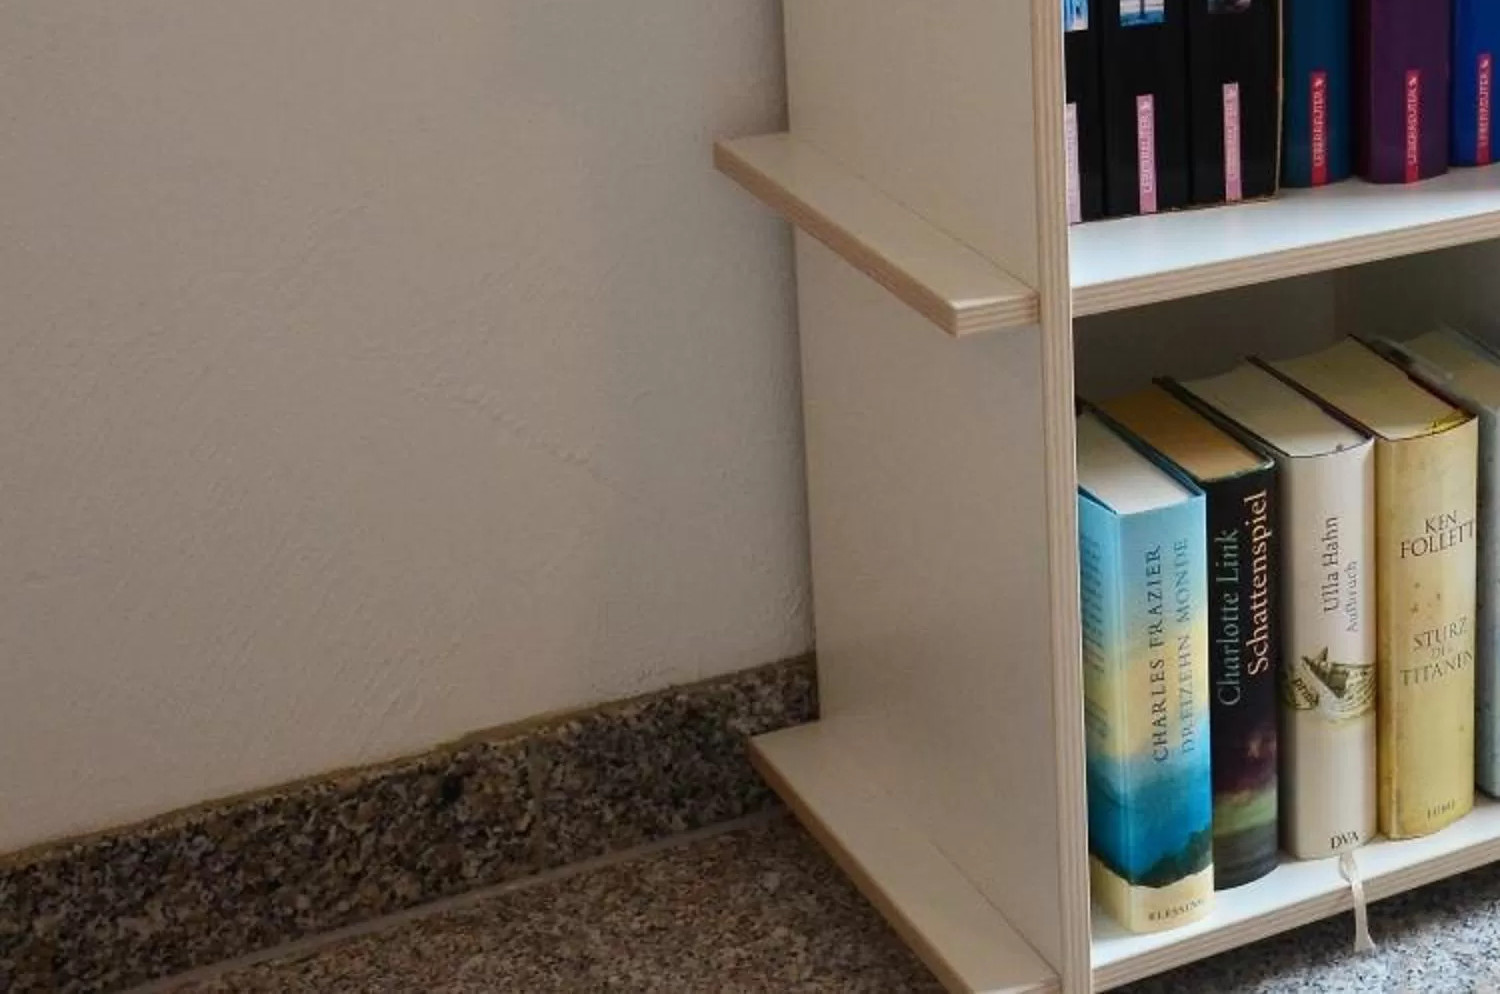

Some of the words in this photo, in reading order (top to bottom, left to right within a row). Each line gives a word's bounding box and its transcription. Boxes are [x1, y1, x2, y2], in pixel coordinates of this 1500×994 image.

[1323, 517, 1339, 563] Hahn
[1400, 518, 1476, 559] FOLLETT
[1425, 510, 1458, 534] KEN
[1216, 529, 1240, 581] Link
[1247, 489, 1271, 673] Schattenspiel
[1145, 546, 1164, 649] FRAZIER
[1173, 539, 1192, 624] MONDE
[1323, 570, 1339, 612] Ulla
[1345, 560, 1359, 632] Aufbruch
[1217, 583, 1241, 705] Charlotte
[1413, 615, 1468, 651] STURZ
[1176, 634, 1195, 754] DREIZEHN
[1400, 651, 1474, 688] TITANEN
[1149, 660, 1169, 763] CHARLES
[1329, 830, 1360, 848] DVA
